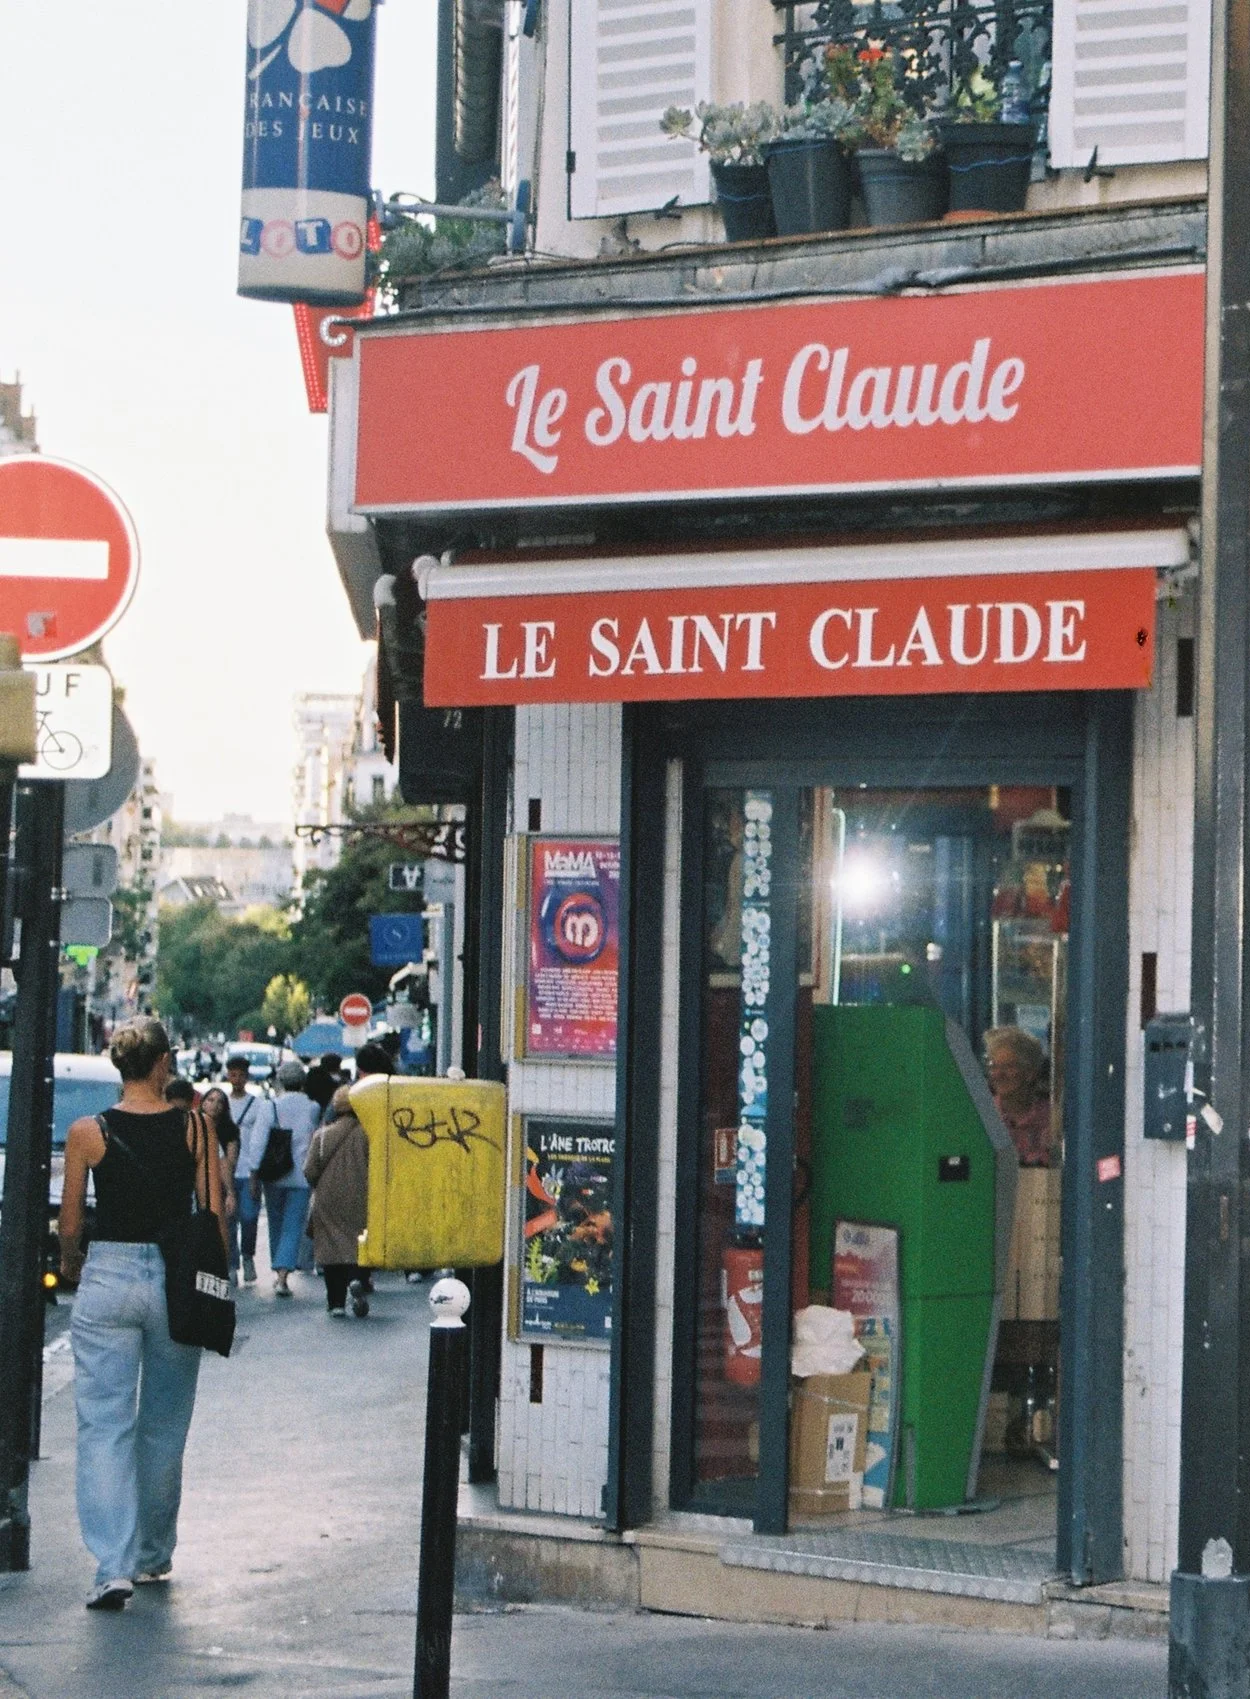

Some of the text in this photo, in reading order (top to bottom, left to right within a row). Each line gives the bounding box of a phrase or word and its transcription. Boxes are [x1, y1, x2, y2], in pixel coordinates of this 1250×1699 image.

[240, 217, 364, 260] LOTO
[505, 336, 1026, 474] Le Saint Claude
[480, 600, 1087, 680] LE SAINT CLAUDE
